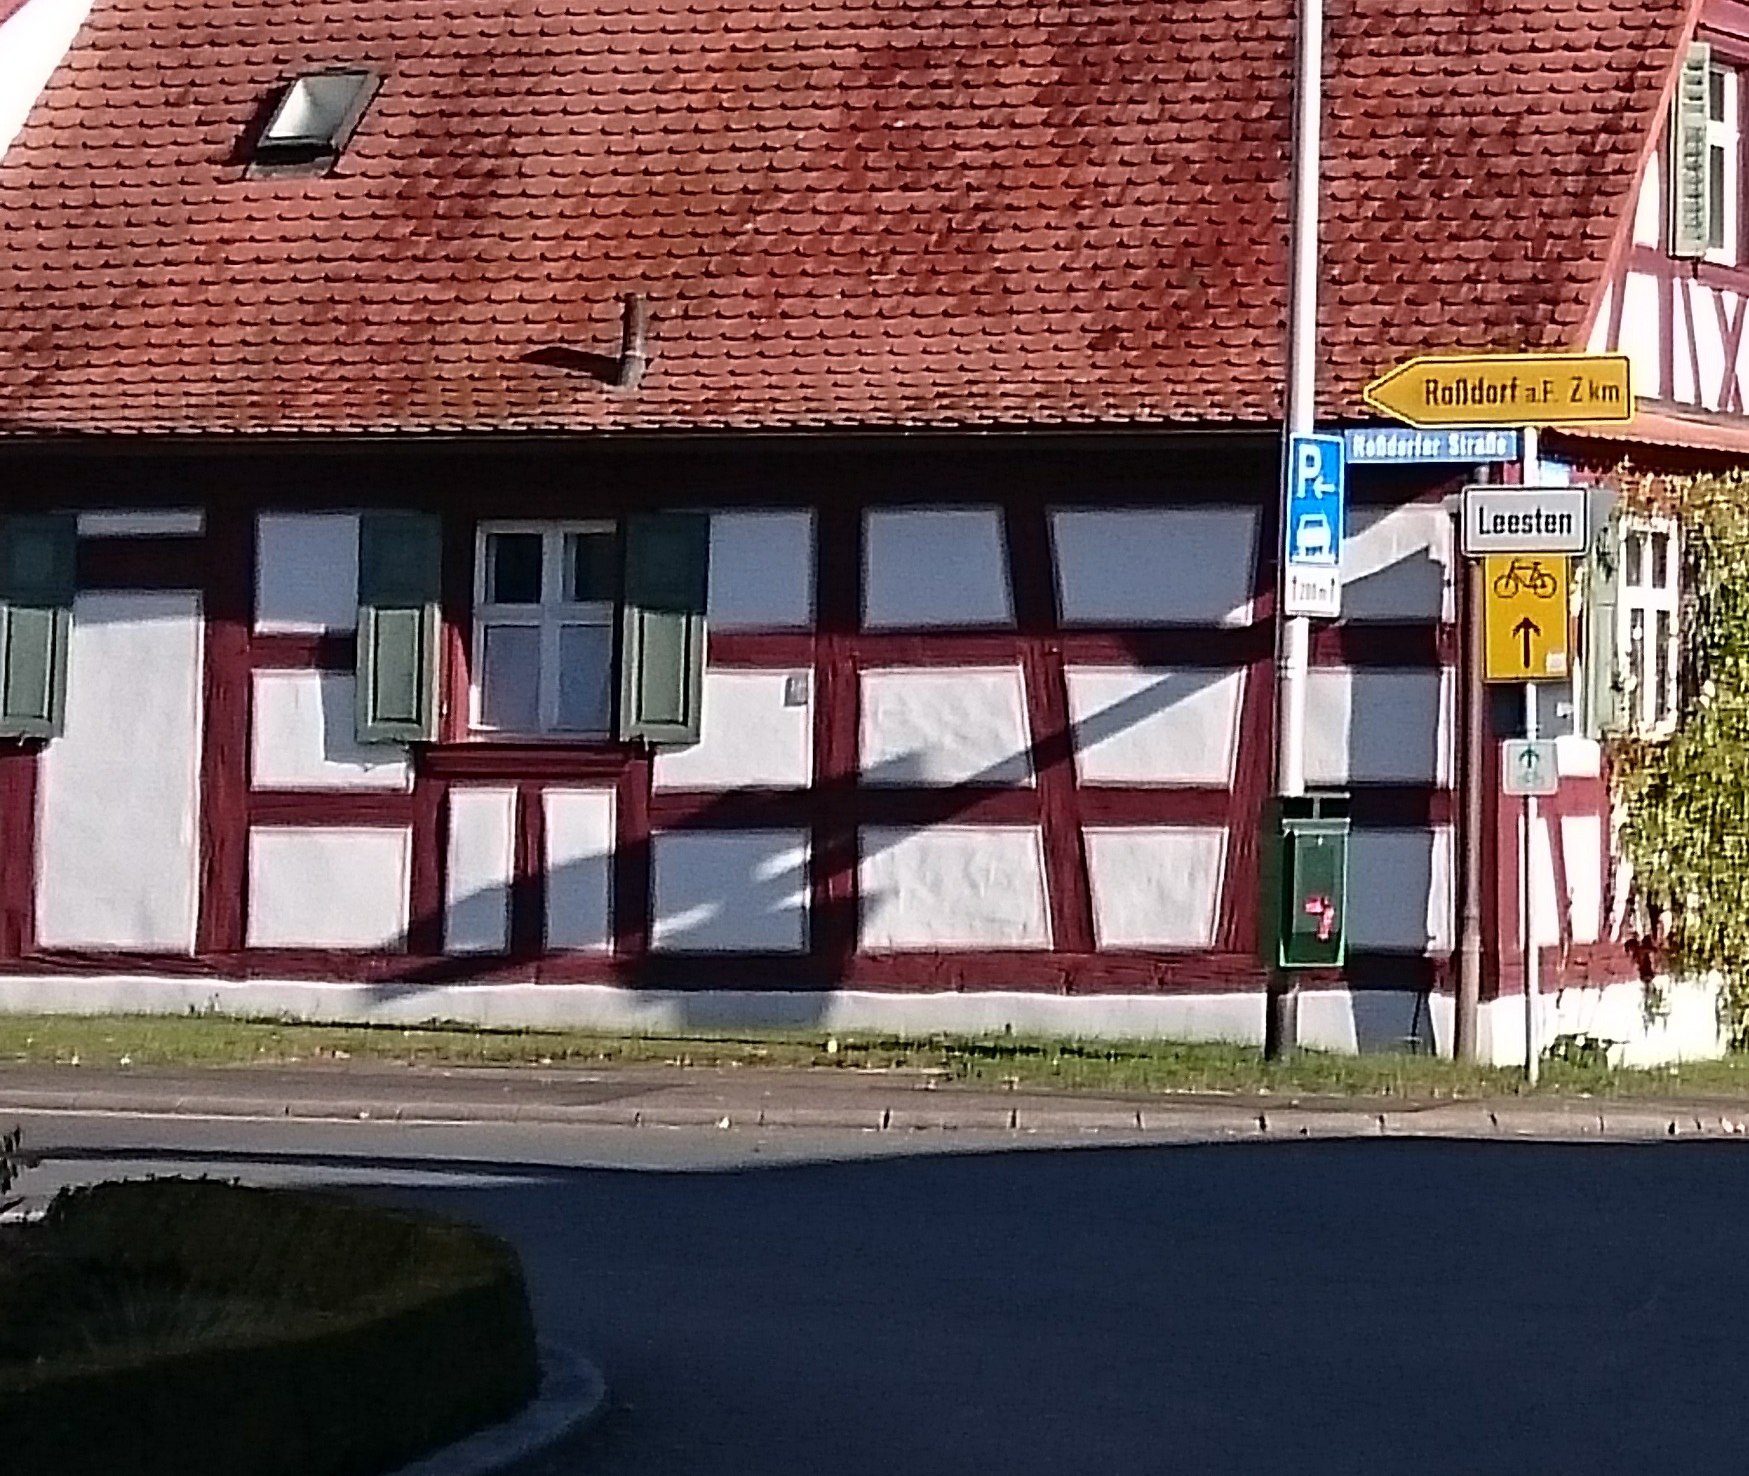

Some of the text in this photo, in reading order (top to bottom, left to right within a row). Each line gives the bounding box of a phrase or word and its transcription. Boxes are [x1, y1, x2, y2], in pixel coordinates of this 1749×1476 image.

[1425, 376, 1518, 406] Roßdorf
[1589, 378, 1620, 403] km
[1353, 431, 1507, 458] Roßdorfer Straße
[1297, 443, 1322, 499] P
[1479, 505, 1572, 535] Leesten
